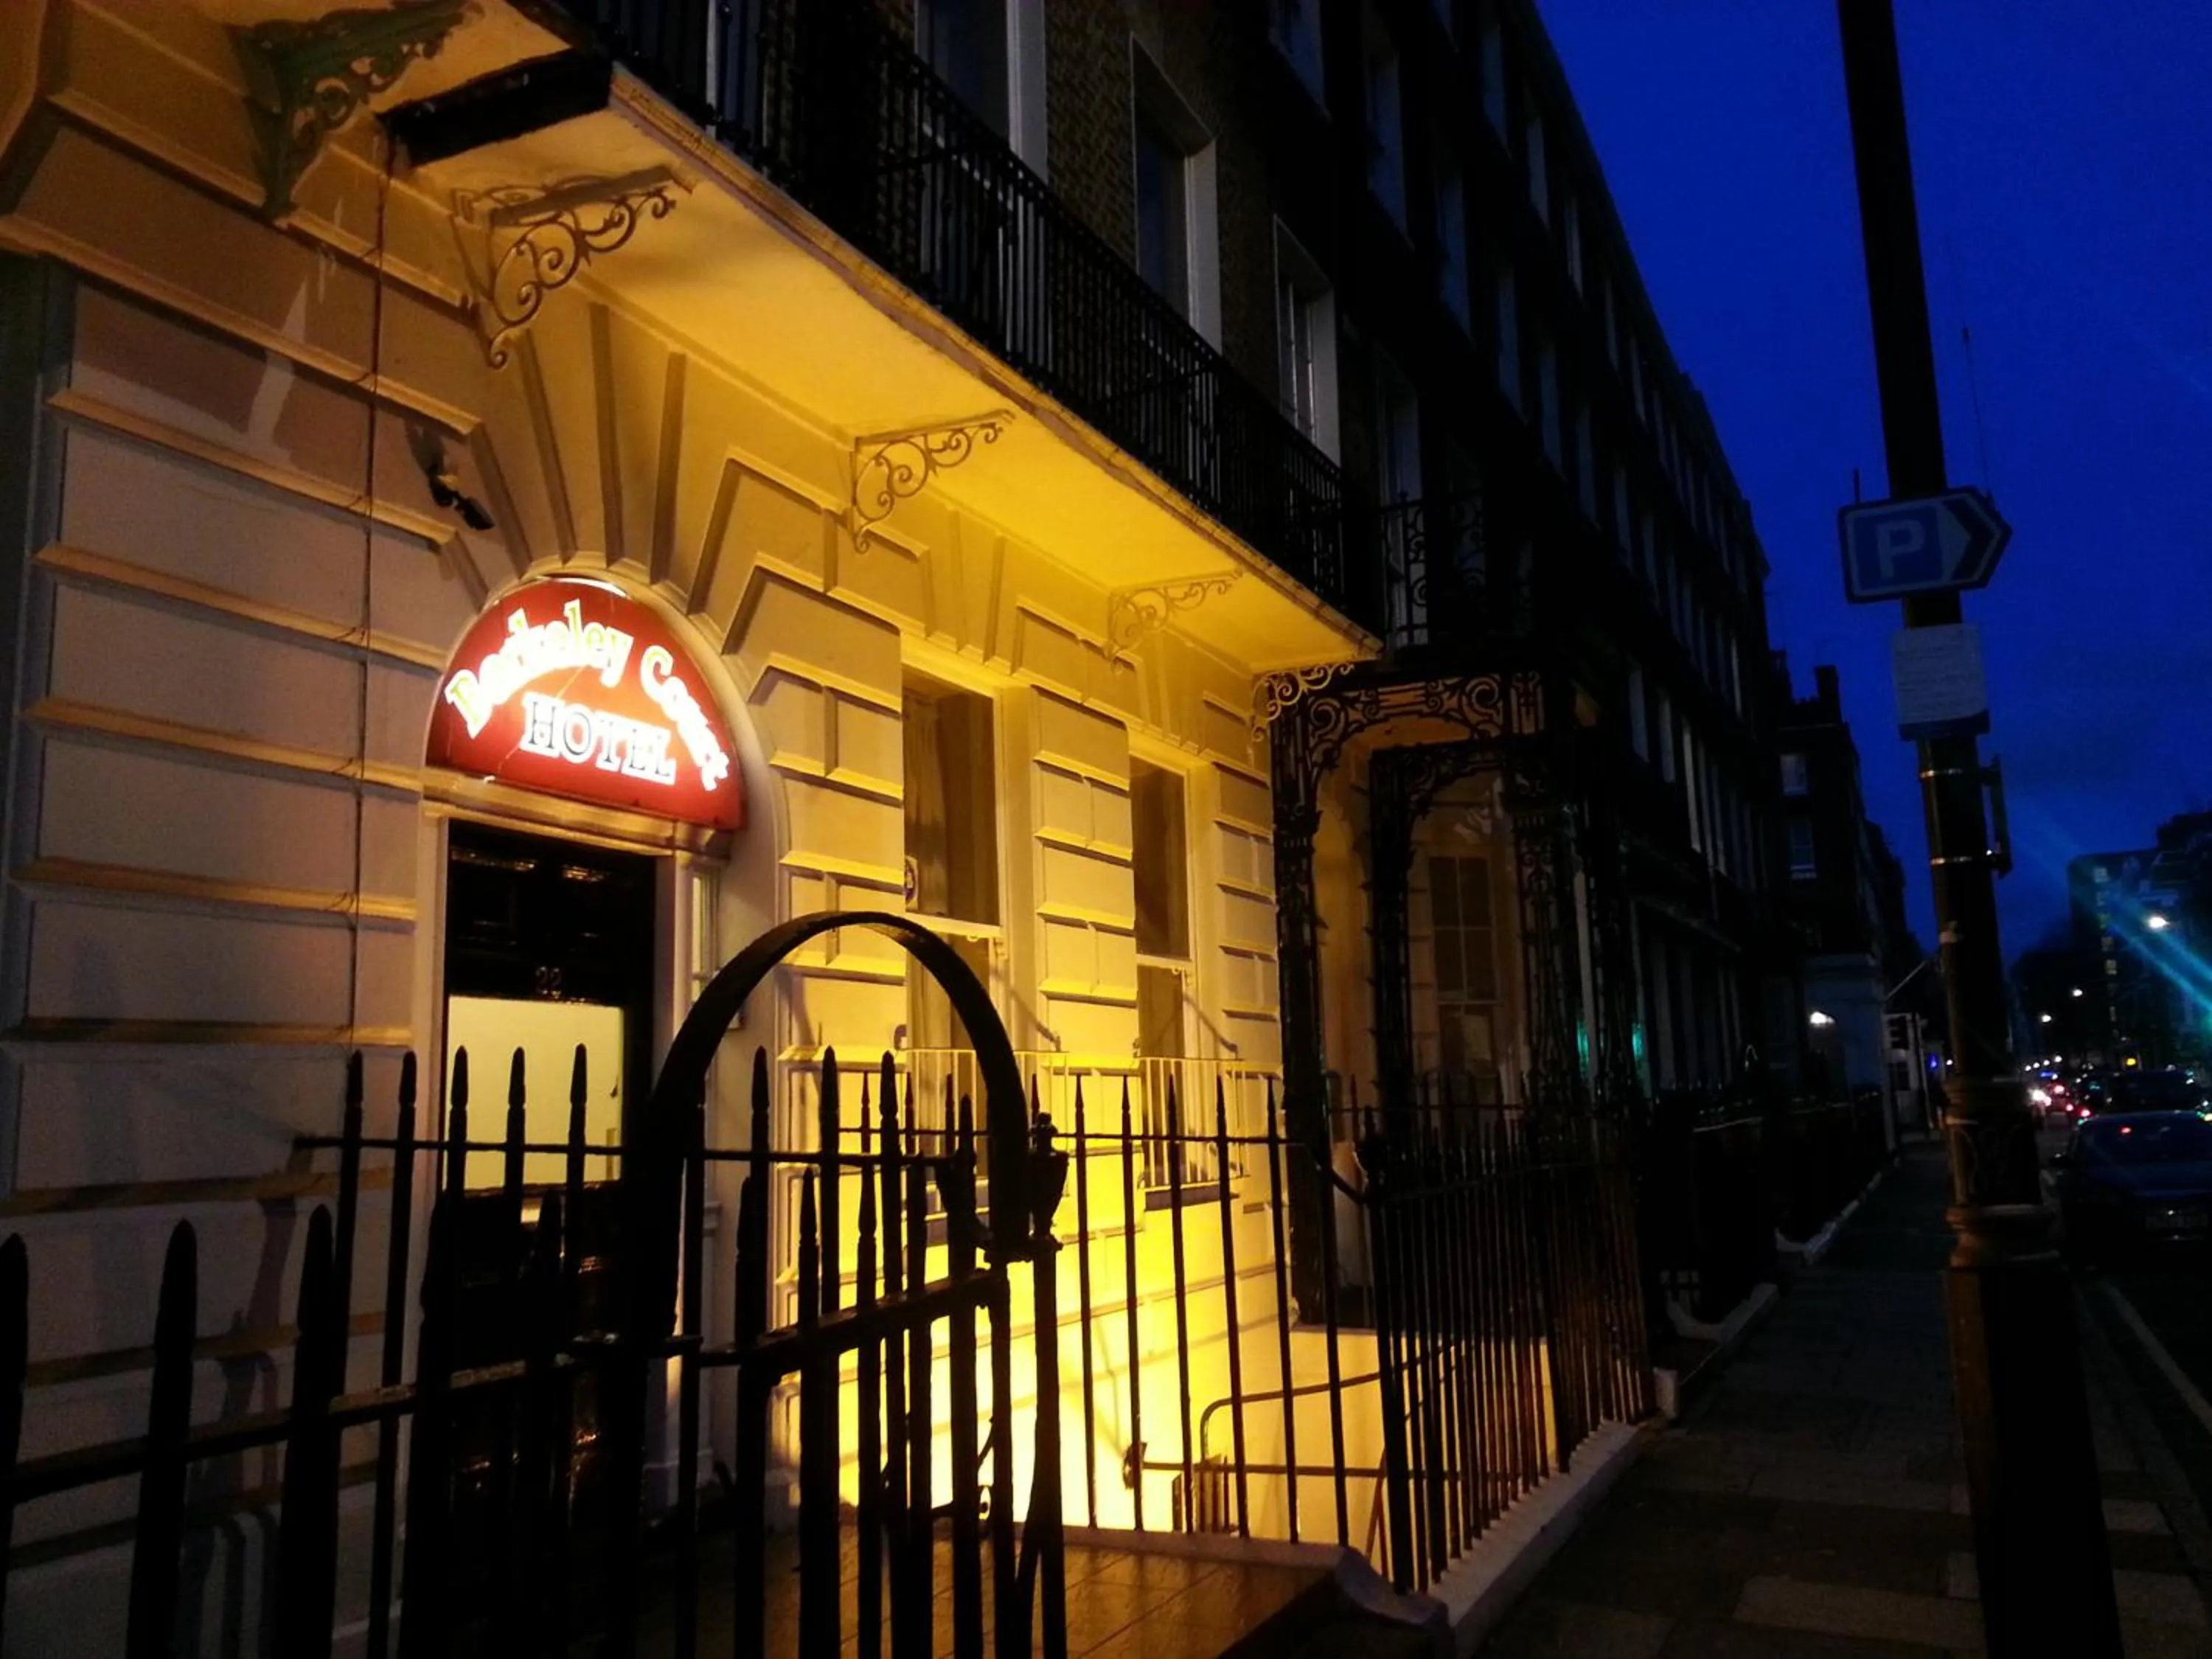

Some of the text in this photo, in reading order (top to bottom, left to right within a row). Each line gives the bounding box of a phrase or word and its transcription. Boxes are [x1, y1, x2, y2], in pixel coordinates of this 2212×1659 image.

[1876, 519, 1926, 579] P
[522, 693, 675, 784] HOTEL
[534, 965, 563, 995] 22
